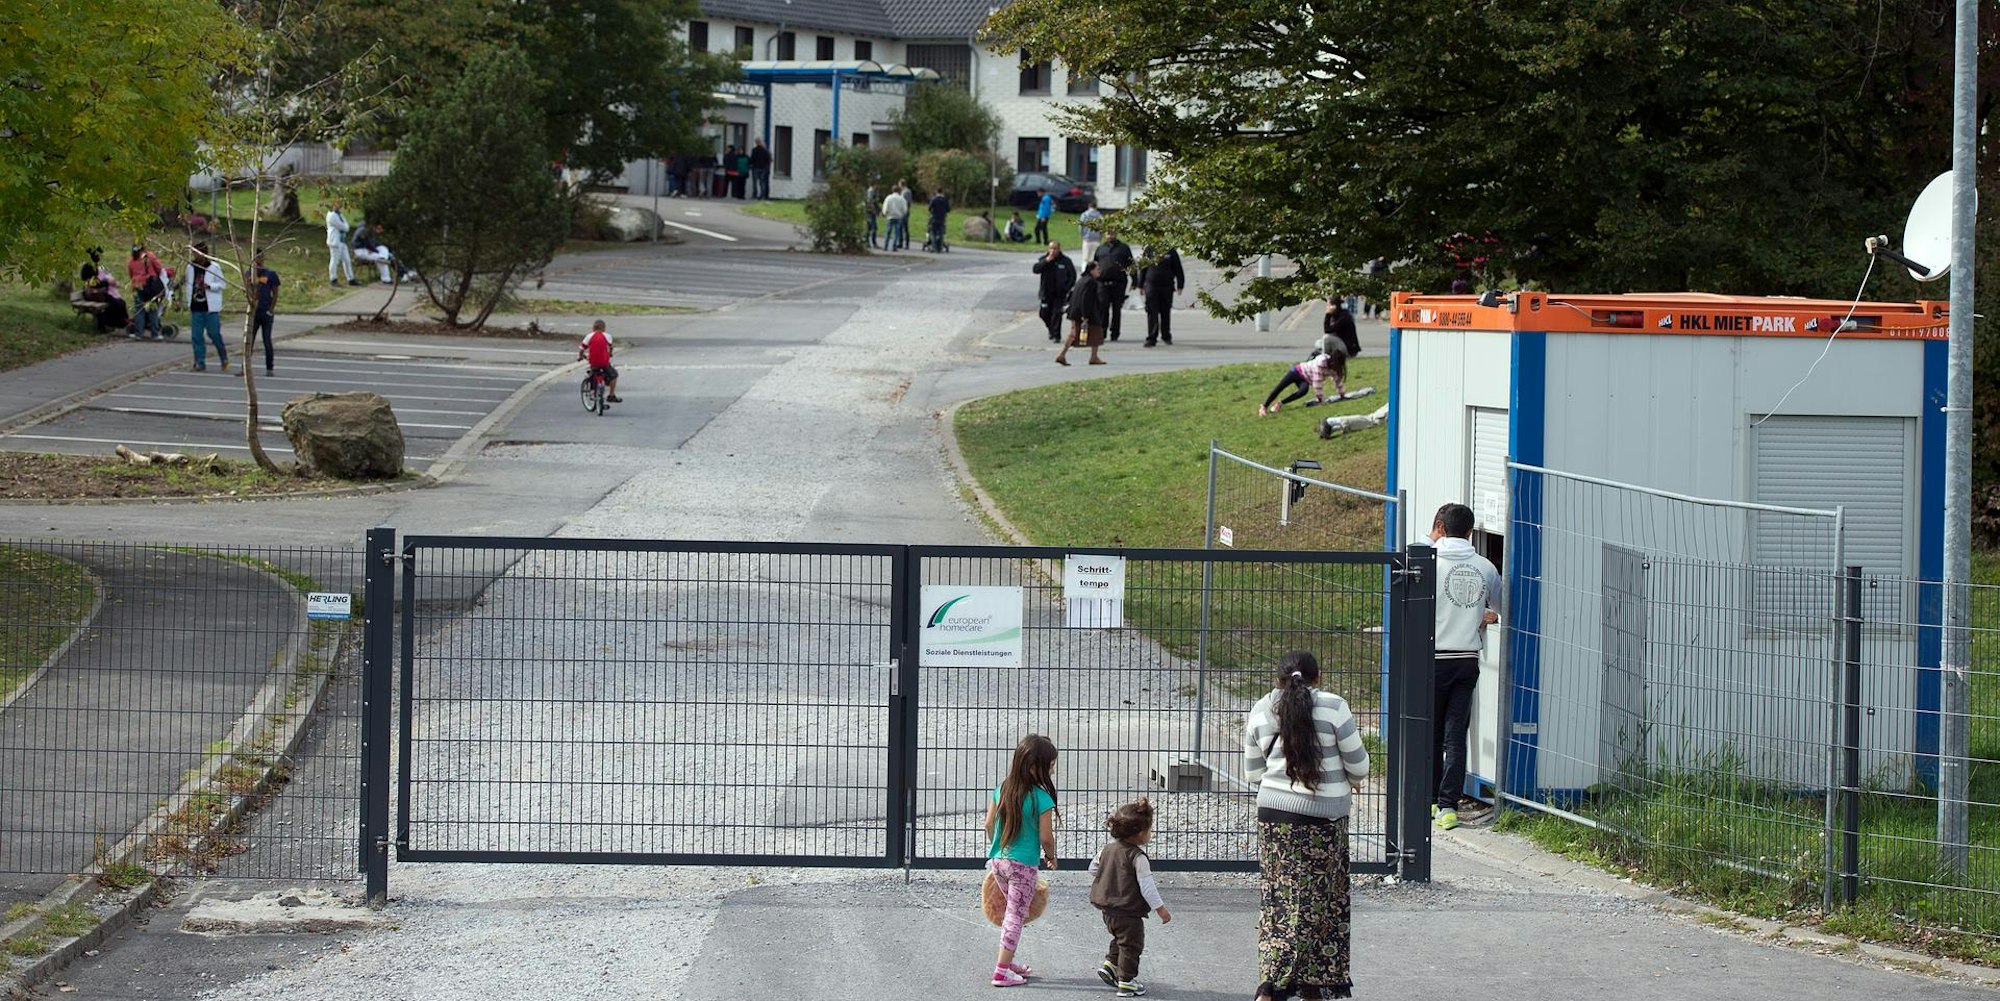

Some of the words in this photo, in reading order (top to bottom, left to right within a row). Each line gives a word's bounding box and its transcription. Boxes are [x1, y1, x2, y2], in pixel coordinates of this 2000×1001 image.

[1680, 315, 1710, 330] HKL
[1714, 315, 1796, 332] MIETPARK
[1077, 565, 1112, 574] Schritt-
[1080, 580, 1109, 588] tempo
[310, 595, 348, 604] HERLING
[940, 624, 983, 632] homecare
[953, 649, 1012, 657] Dienstleistungen
